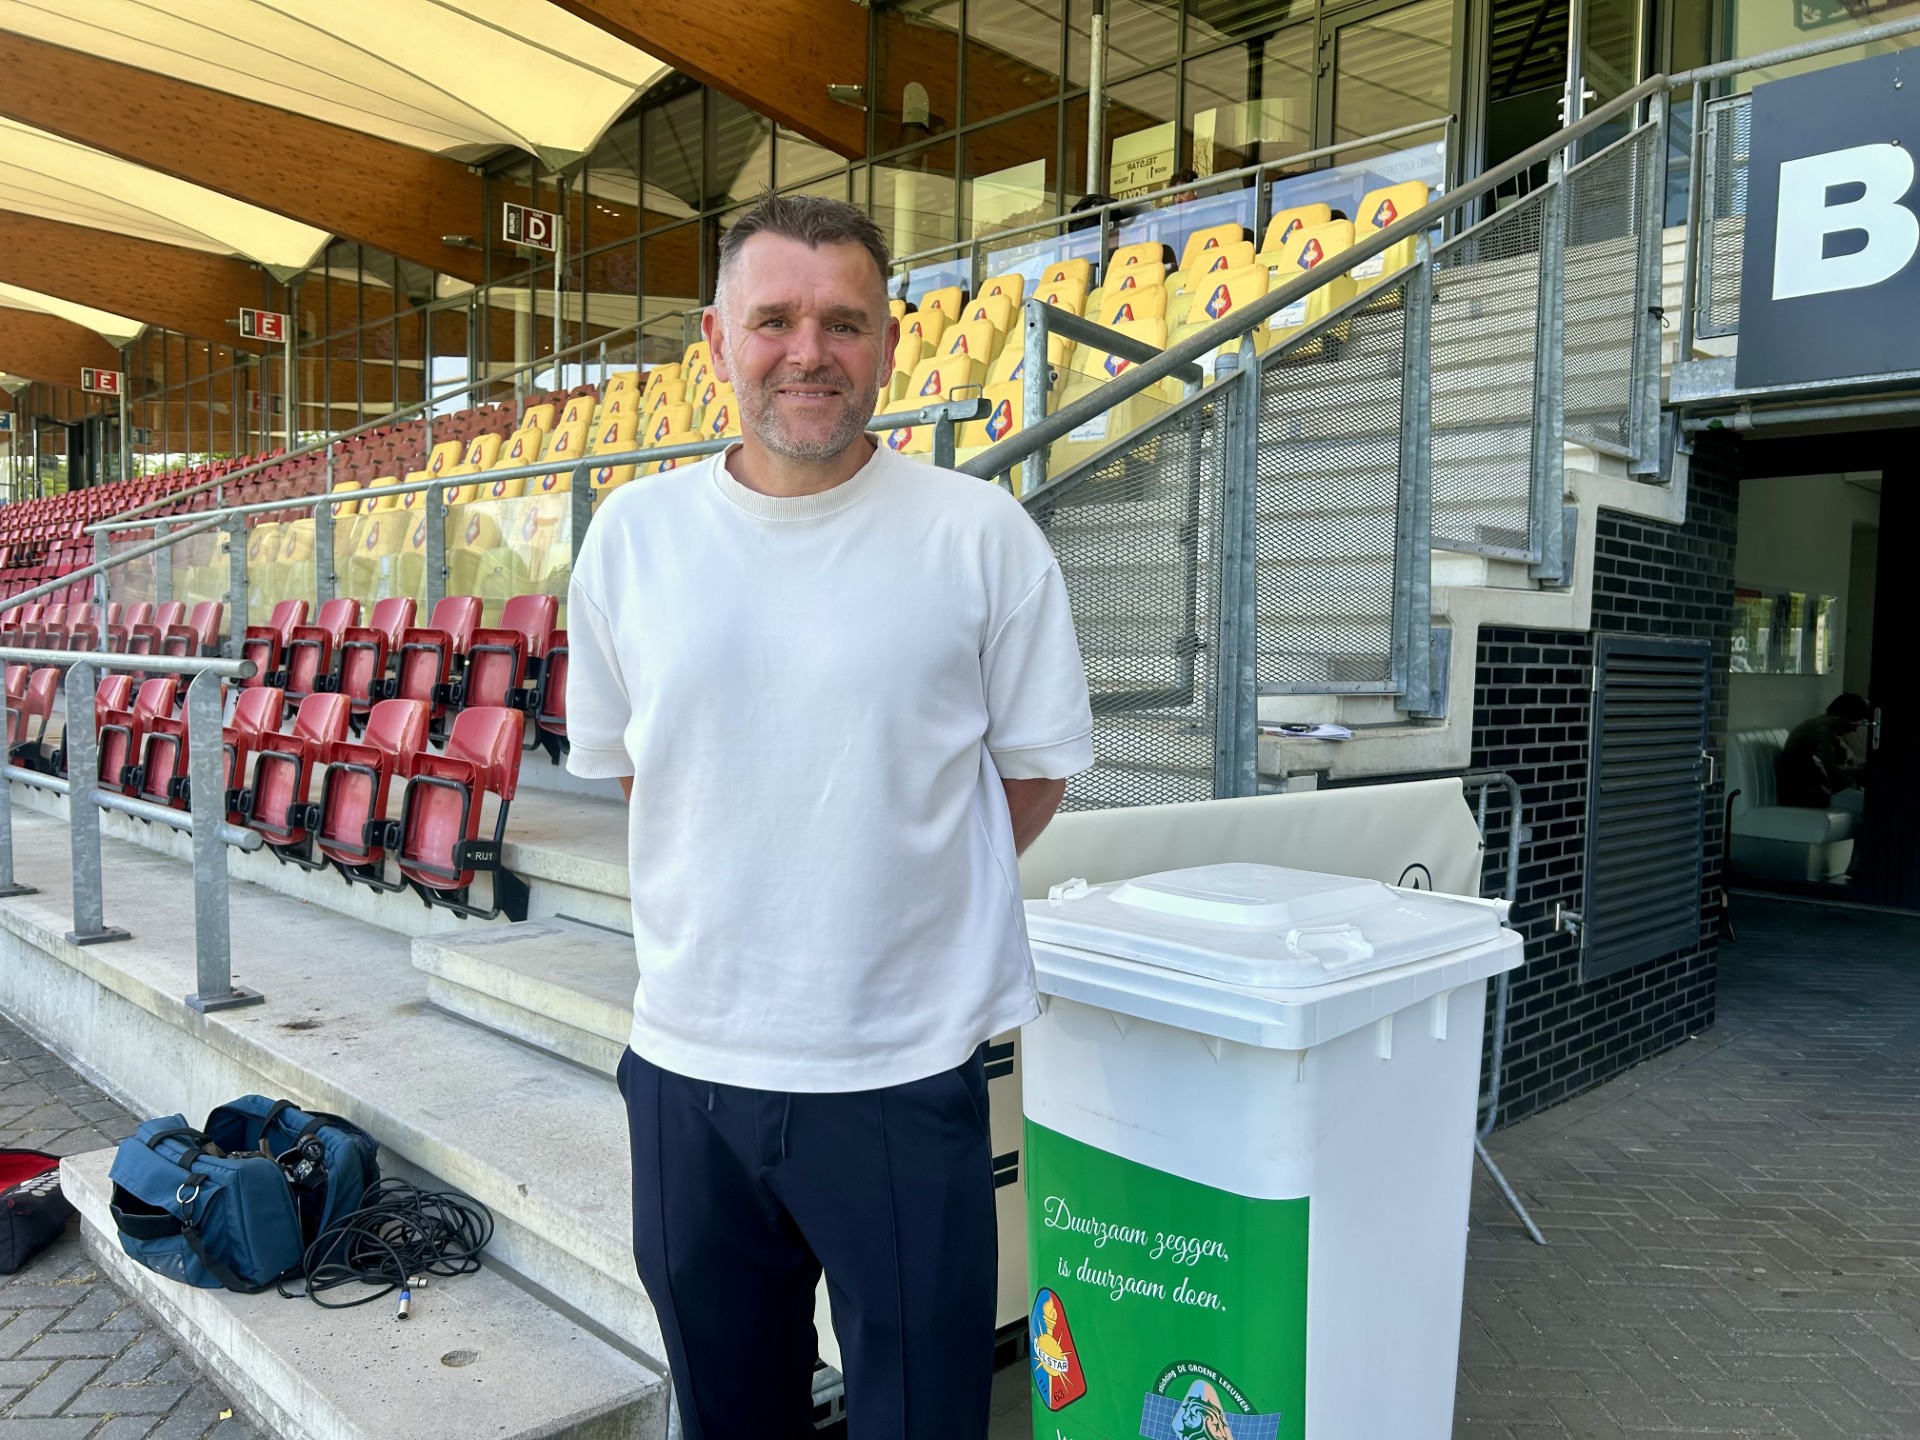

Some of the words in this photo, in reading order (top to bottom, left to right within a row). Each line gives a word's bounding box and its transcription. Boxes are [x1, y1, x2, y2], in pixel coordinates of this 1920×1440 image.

[529, 217, 546, 240] D
[1772, 143, 1920, 301] B
[262, 318, 275, 335] E
[100, 374, 112, 389] E
[475, 852, 493, 860] RIJ1
[1043, 1195, 1148, 1248] Duurzaam
[1149, 1231, 1229, 1266] zeggen,
[1057, 1256, 1071, 1277] is
[1076, 1256, 1166, 1300] duurzaam
[1172, 1276, 1227, 1311] doen.
[1034, 1342, 1068, 1370] TELSTAR
[1158, 1369, 1177, 1393] stichting
[1177, 1364, 1187, 1373] DE
[1187, 1363, 1217, 1380] GROENE
[1218, 1376, 1250, 1412] LEEUWEN
